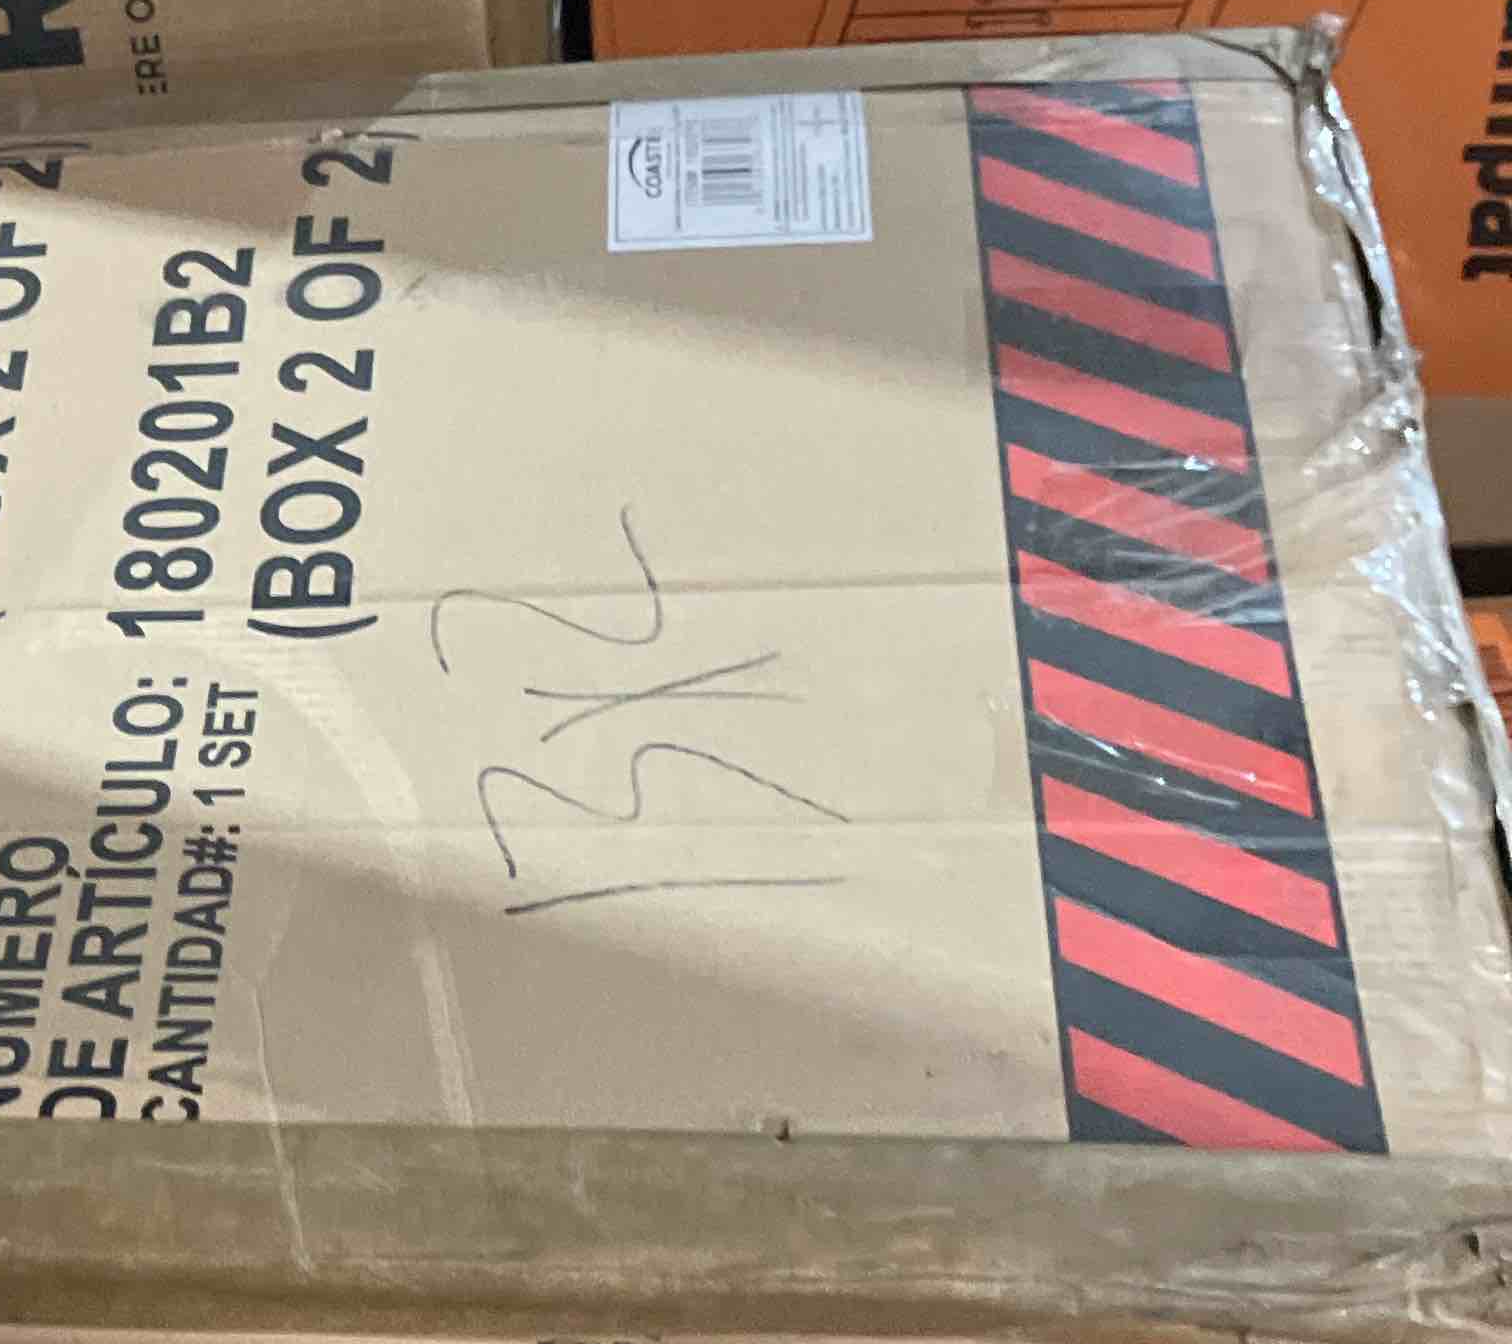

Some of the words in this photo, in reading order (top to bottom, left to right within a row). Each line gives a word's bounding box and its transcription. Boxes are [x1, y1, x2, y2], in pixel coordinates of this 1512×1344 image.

[286, 214, 385, 322] OF
[278, 348, 375, 393] 2
[105, 247, 256, 639] 180201B2
[246, 416, 379, 640] (BOX
[197, 681, 260, 769] SET
[61, 675, 188, 1020] ARTÍCULO:
[192, 787, 246, 806] 1
[140, 824, 242, 1121] CANTIDAD#:
[38, 1037, 129, 1120] DE
